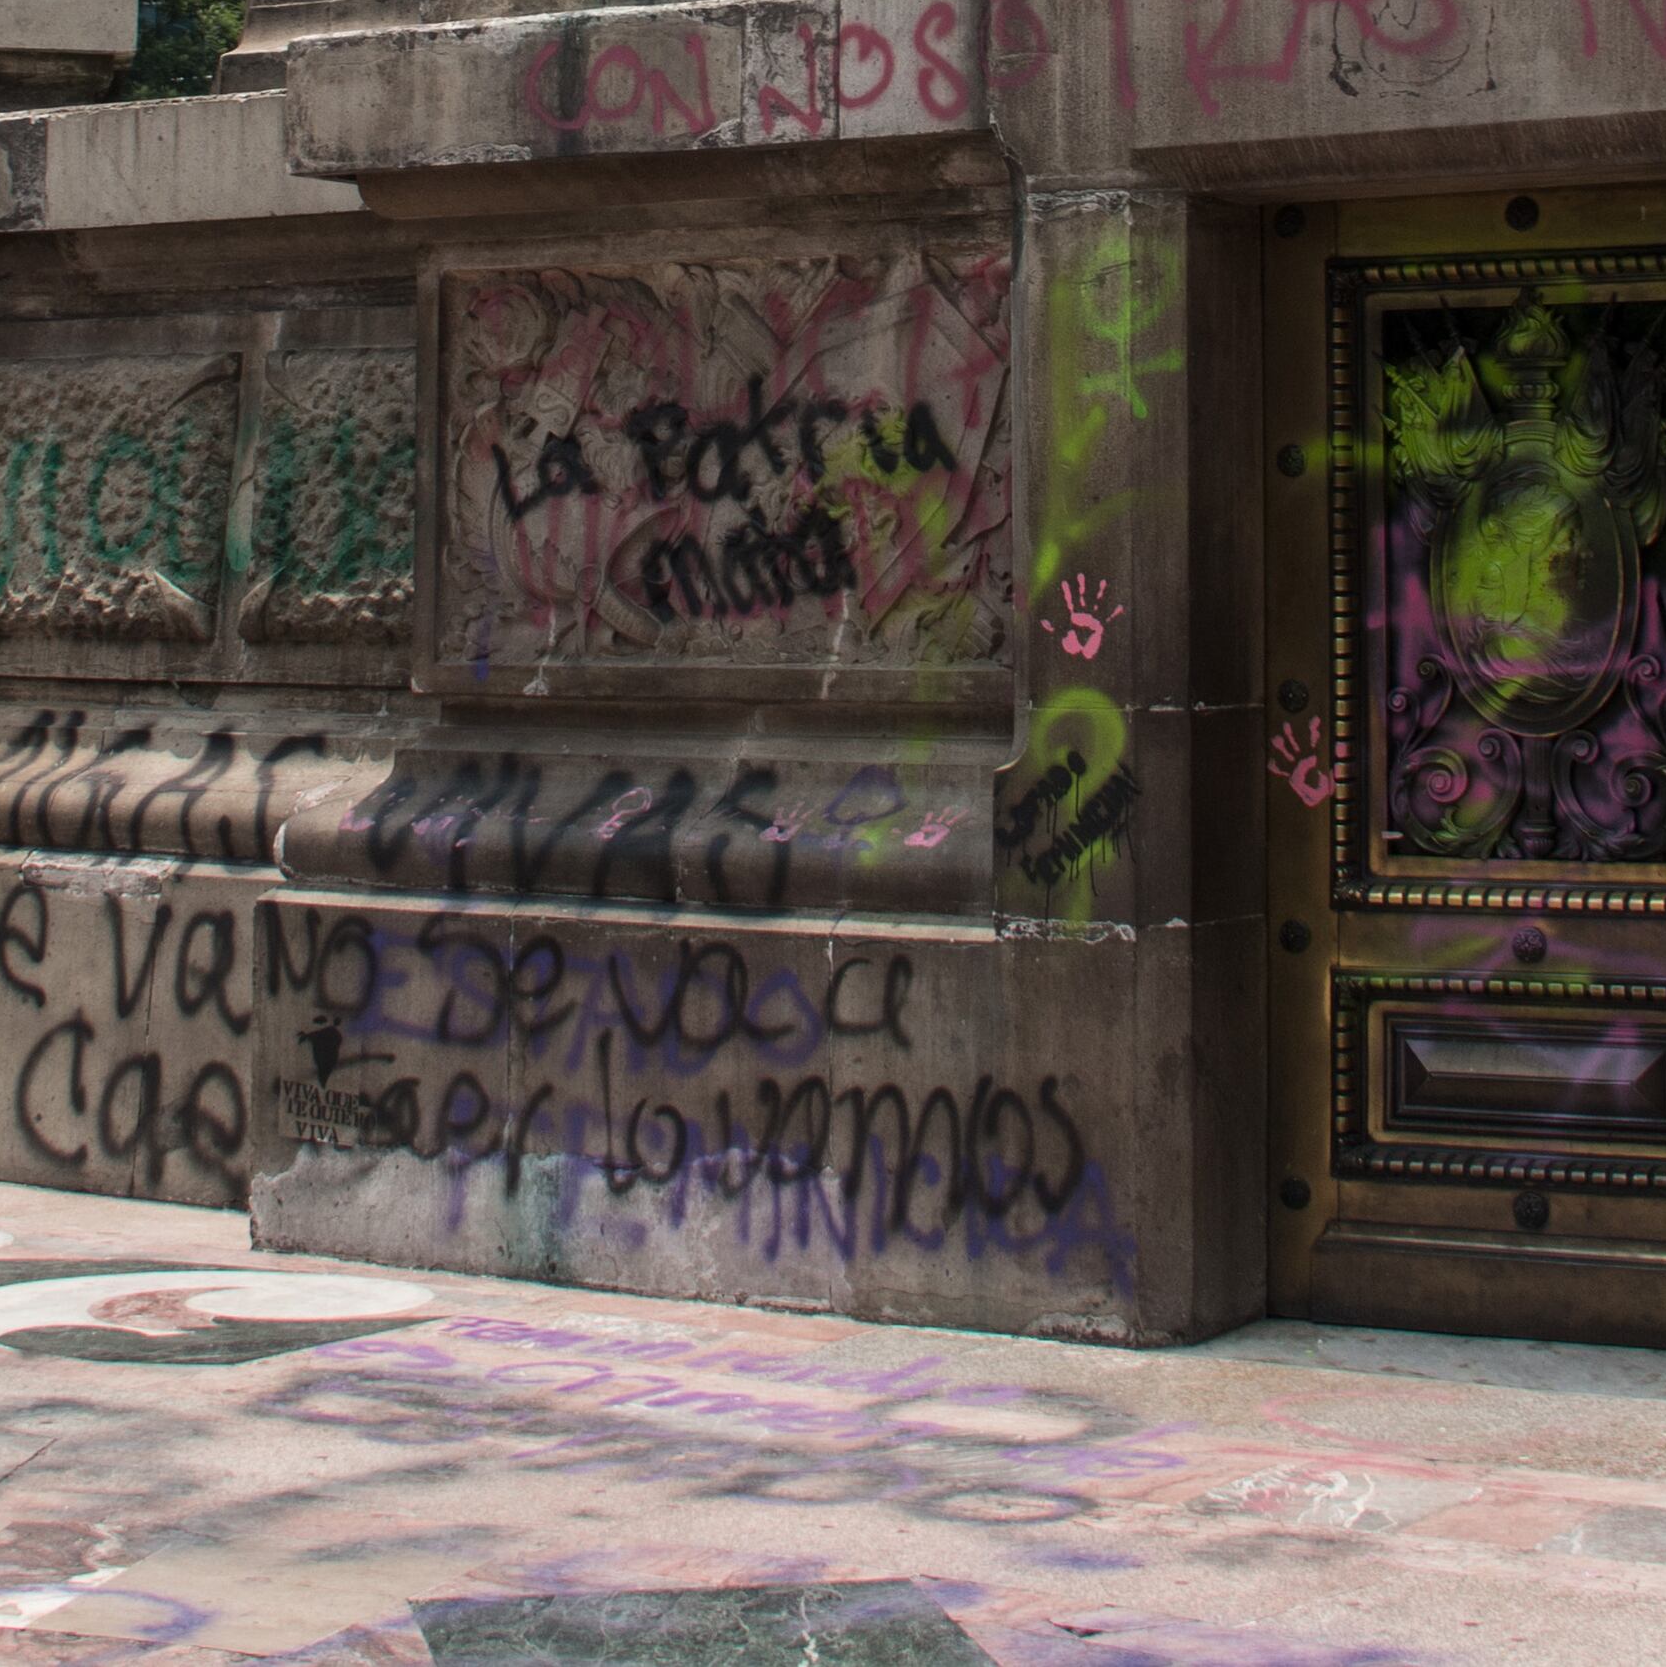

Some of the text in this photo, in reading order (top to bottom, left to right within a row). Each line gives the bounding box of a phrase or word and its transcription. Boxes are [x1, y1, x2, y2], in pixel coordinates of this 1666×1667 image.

[523, 31, 718, 133] CON
[283, 1080, 359, 1109] VIVA QUE
[286, 1098, 308, 1117] TE
[294, 1119, 339, 1144] VIVA
